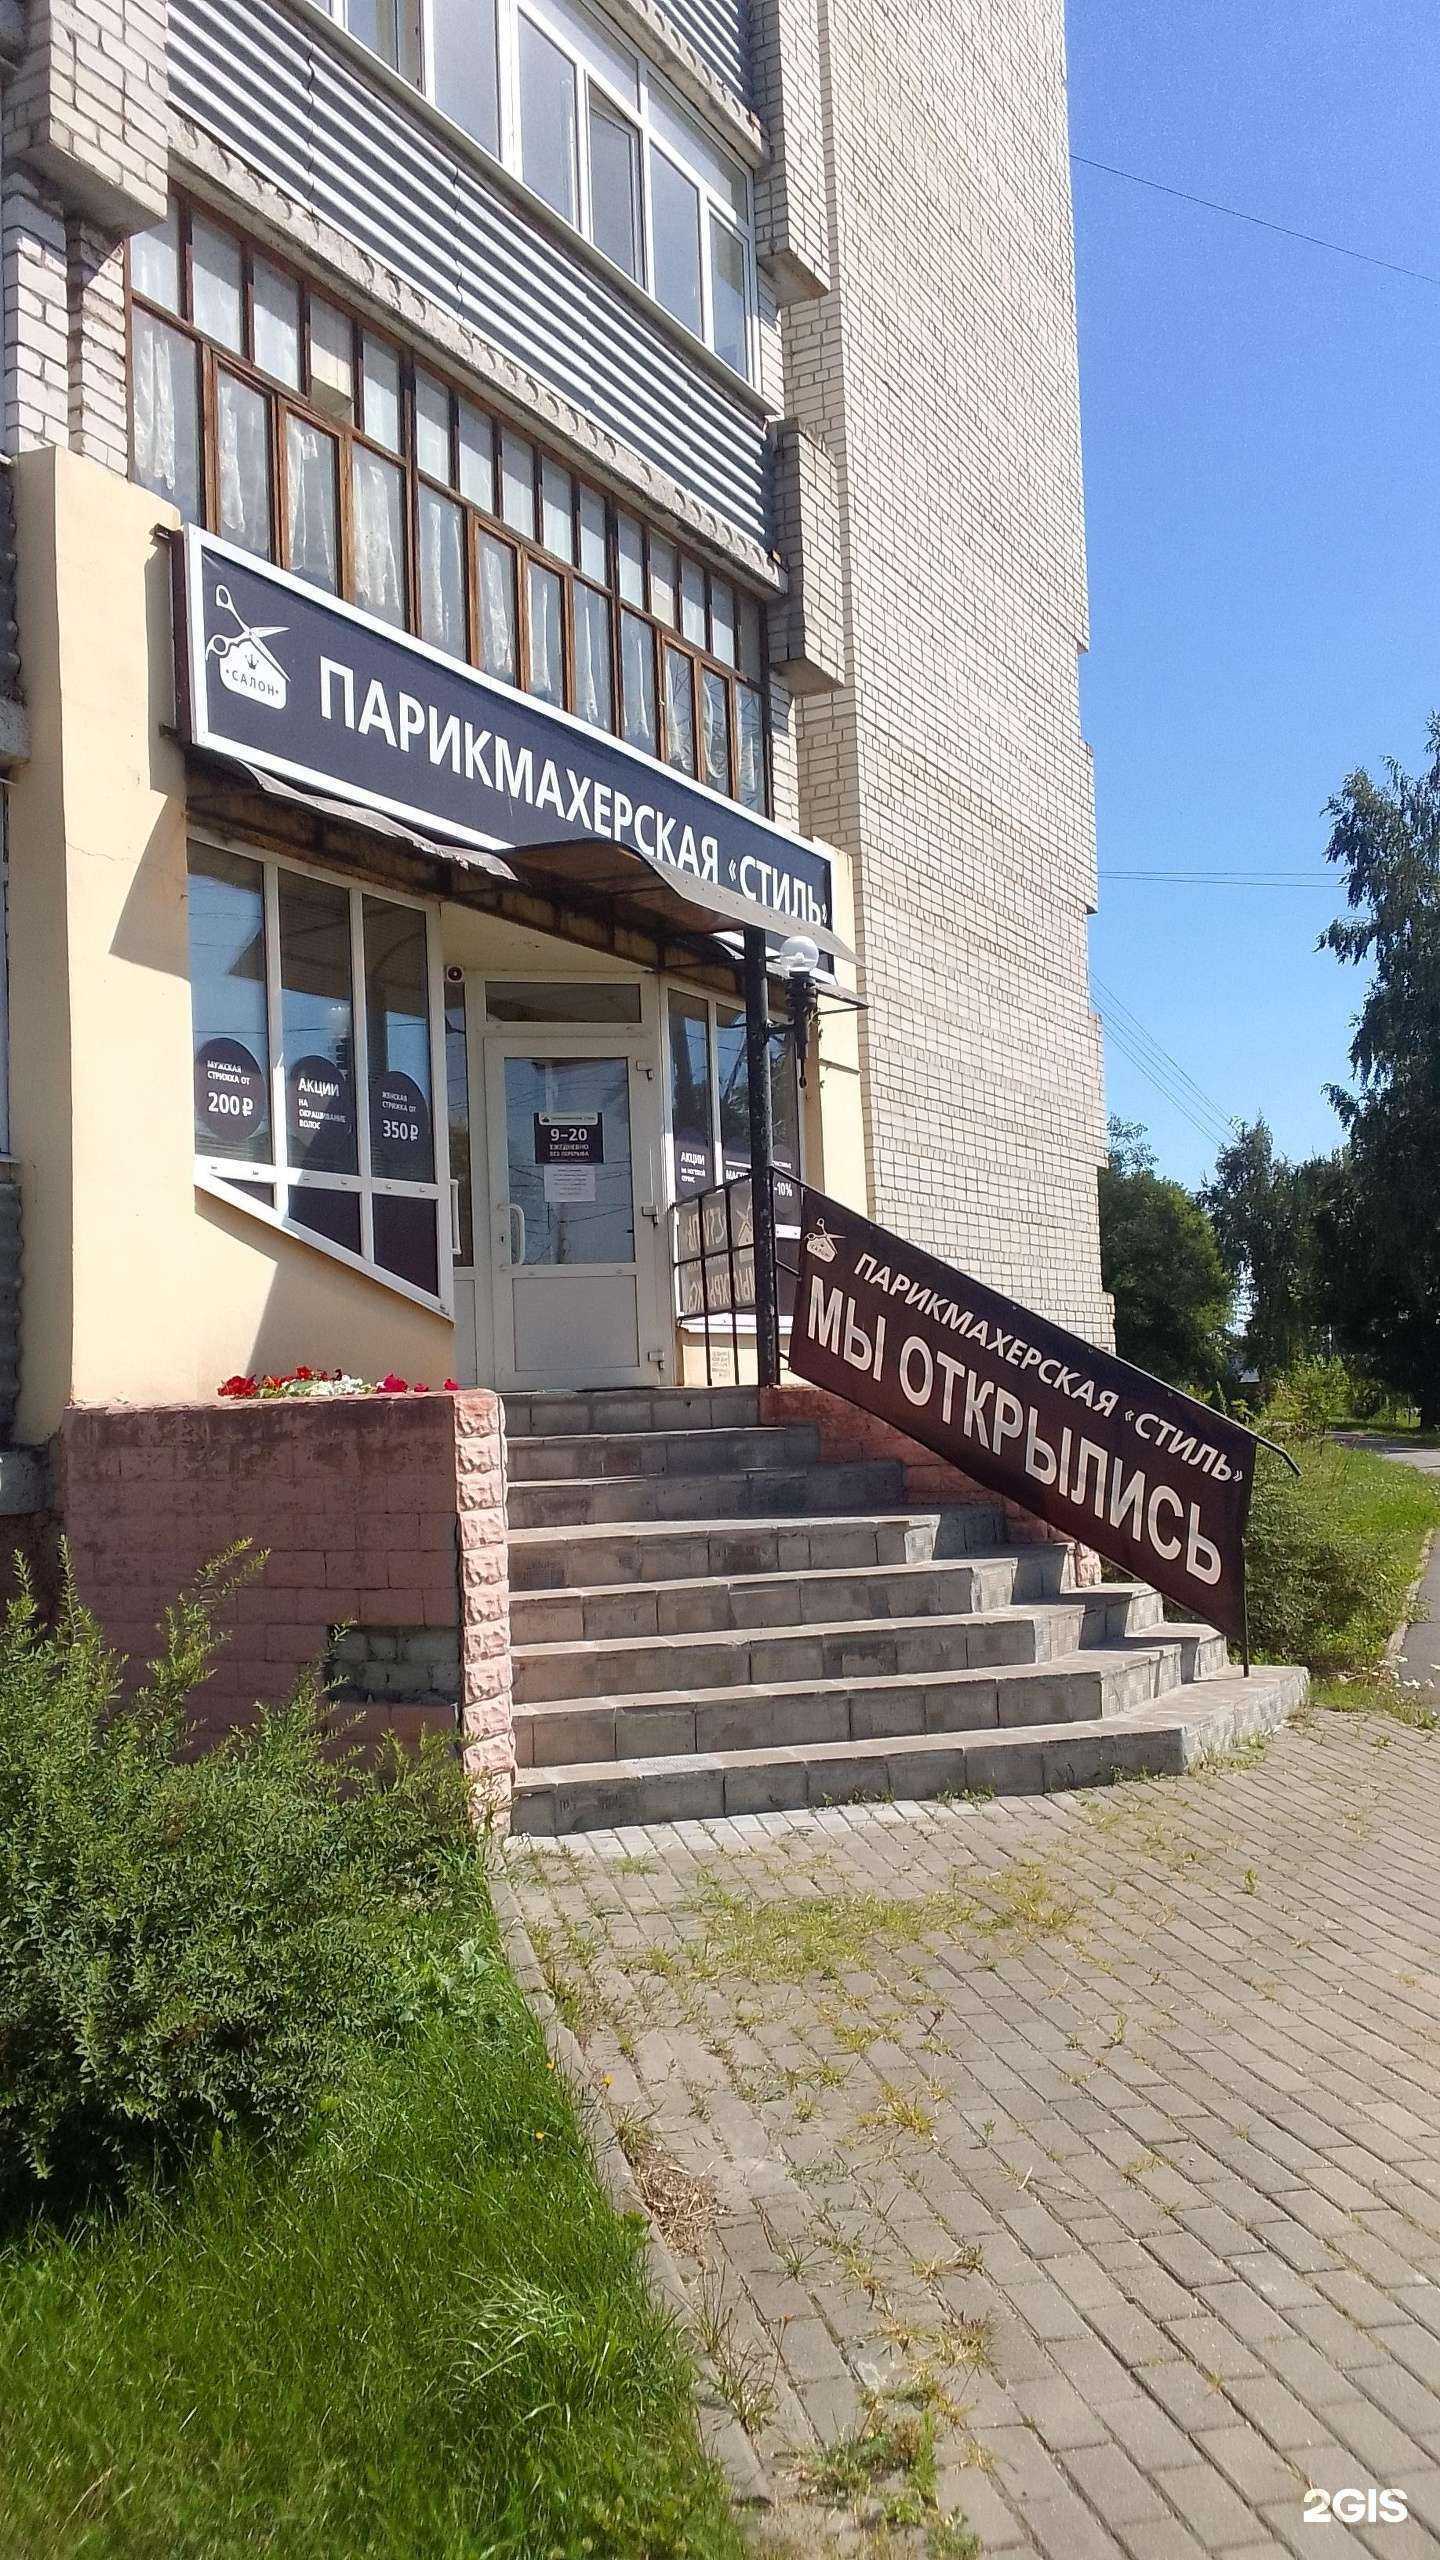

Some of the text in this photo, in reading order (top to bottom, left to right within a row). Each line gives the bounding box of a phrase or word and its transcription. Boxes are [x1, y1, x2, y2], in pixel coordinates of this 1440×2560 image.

[319, 656, 719, 885] ПАРИКМАХЕРСКАЯ
[298, 1077, 340, 1097] АКЦИИ
[680, 1151, 706, 1166] АКЦИИ
[773, 1182, 793, 1197] -10%
[807, 1275, 1222, 1586] МЫ ОТКРЫЛИСЬ
[854, 1252, 1244, 1485] ПАРИКМАХЕРСКАЯ «СТИЛЬ»
